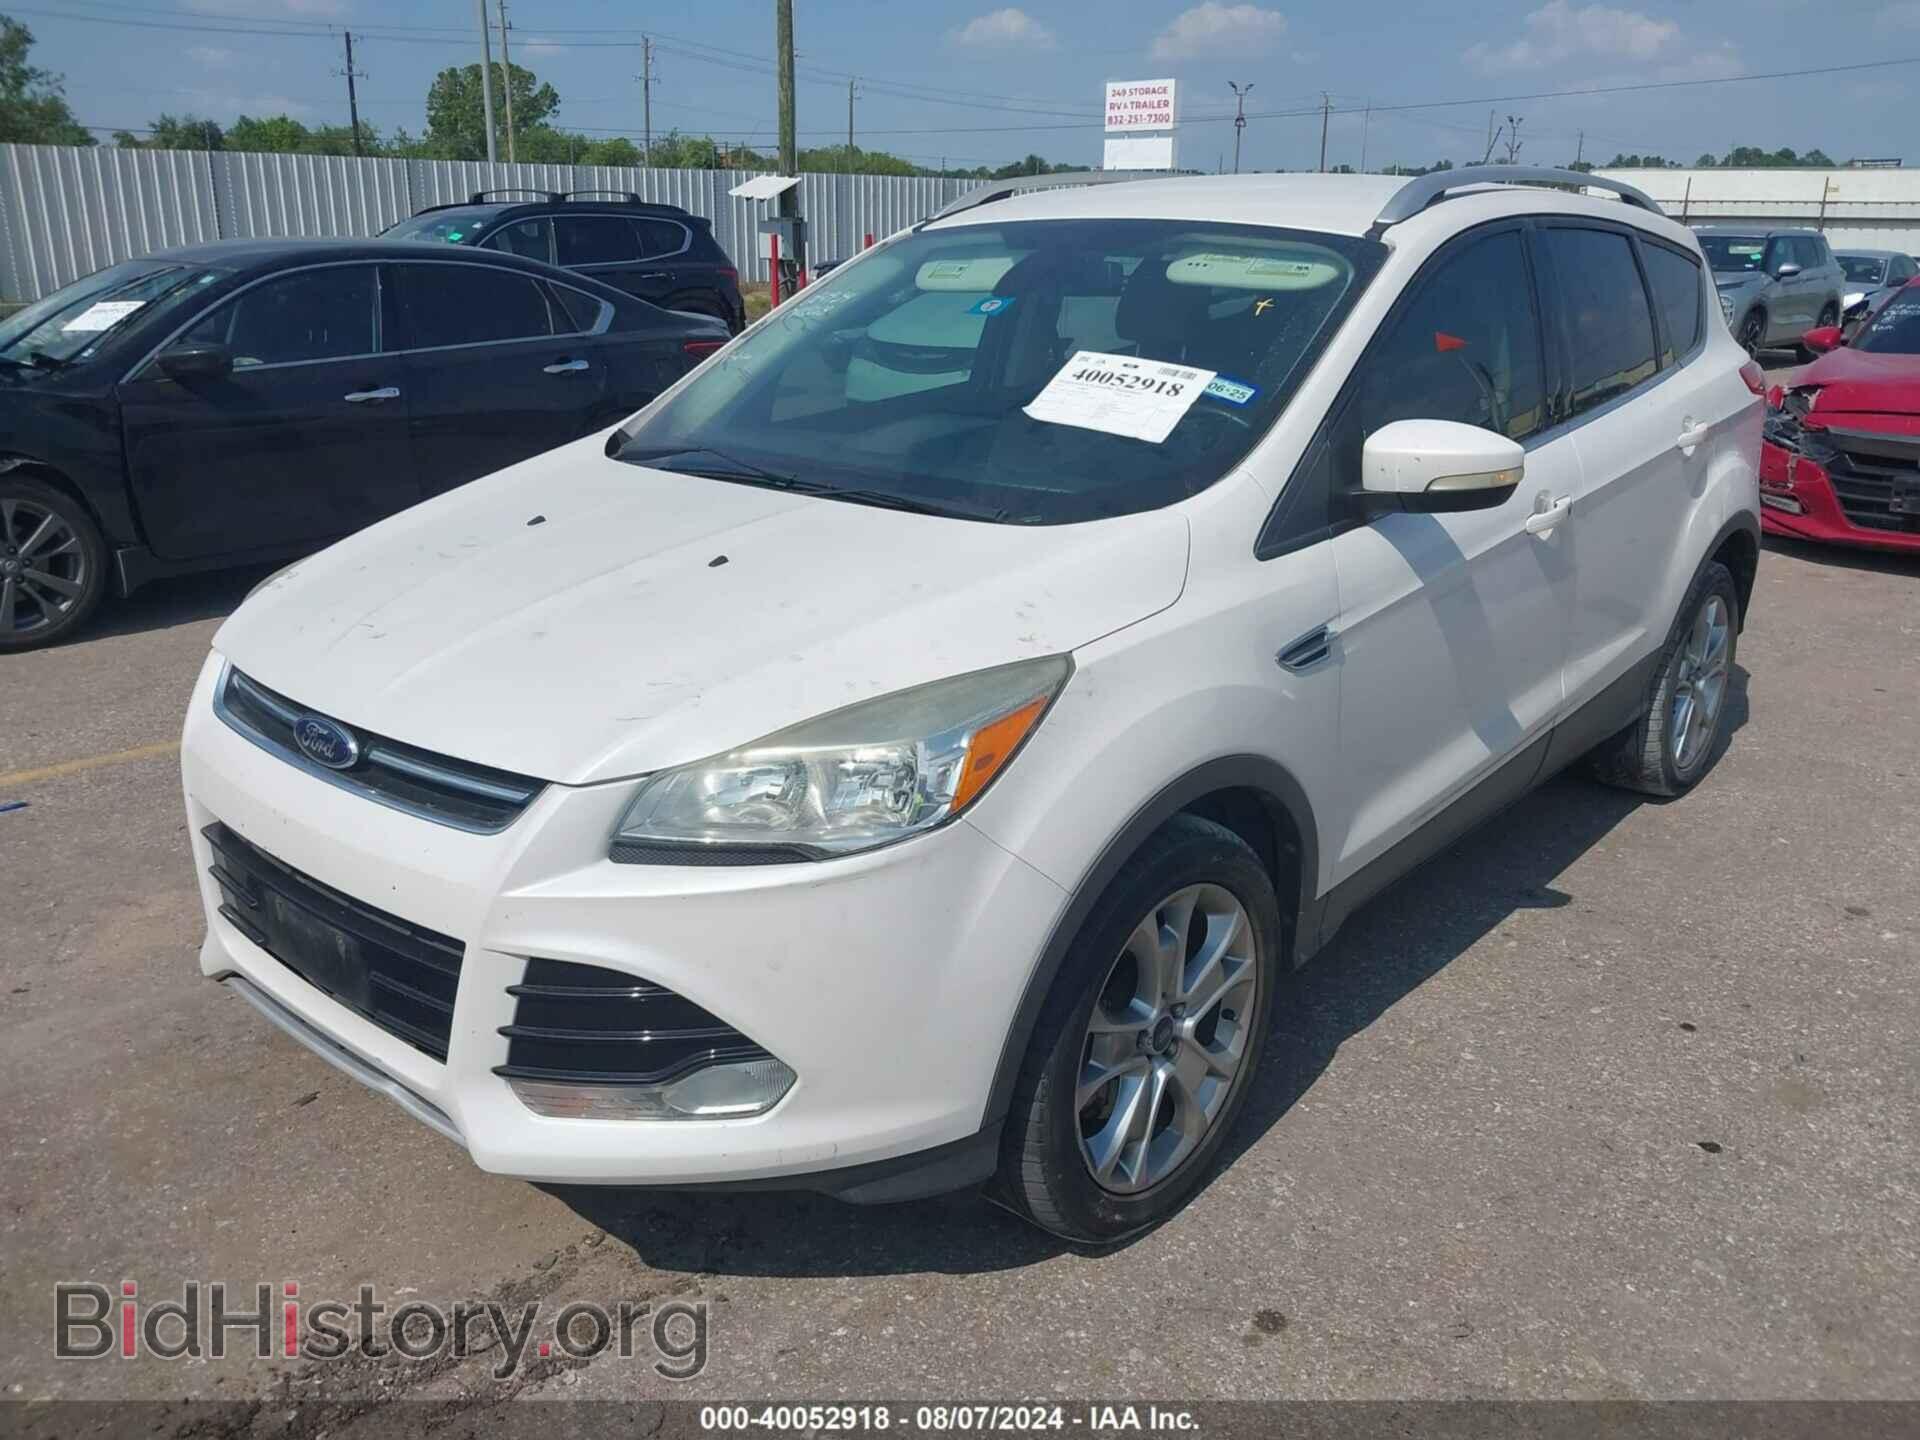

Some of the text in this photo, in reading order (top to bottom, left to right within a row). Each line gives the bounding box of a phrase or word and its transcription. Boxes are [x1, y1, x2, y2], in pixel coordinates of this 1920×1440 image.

[1128, 86, 1168, 96] STORAGE
[1109, 102, 1121, 111] RV
[1130, 99, 1169, 110] TRAILER
[1072, 368, 1184, 397] 40052918
[302, 722, 336, 760] Ford
